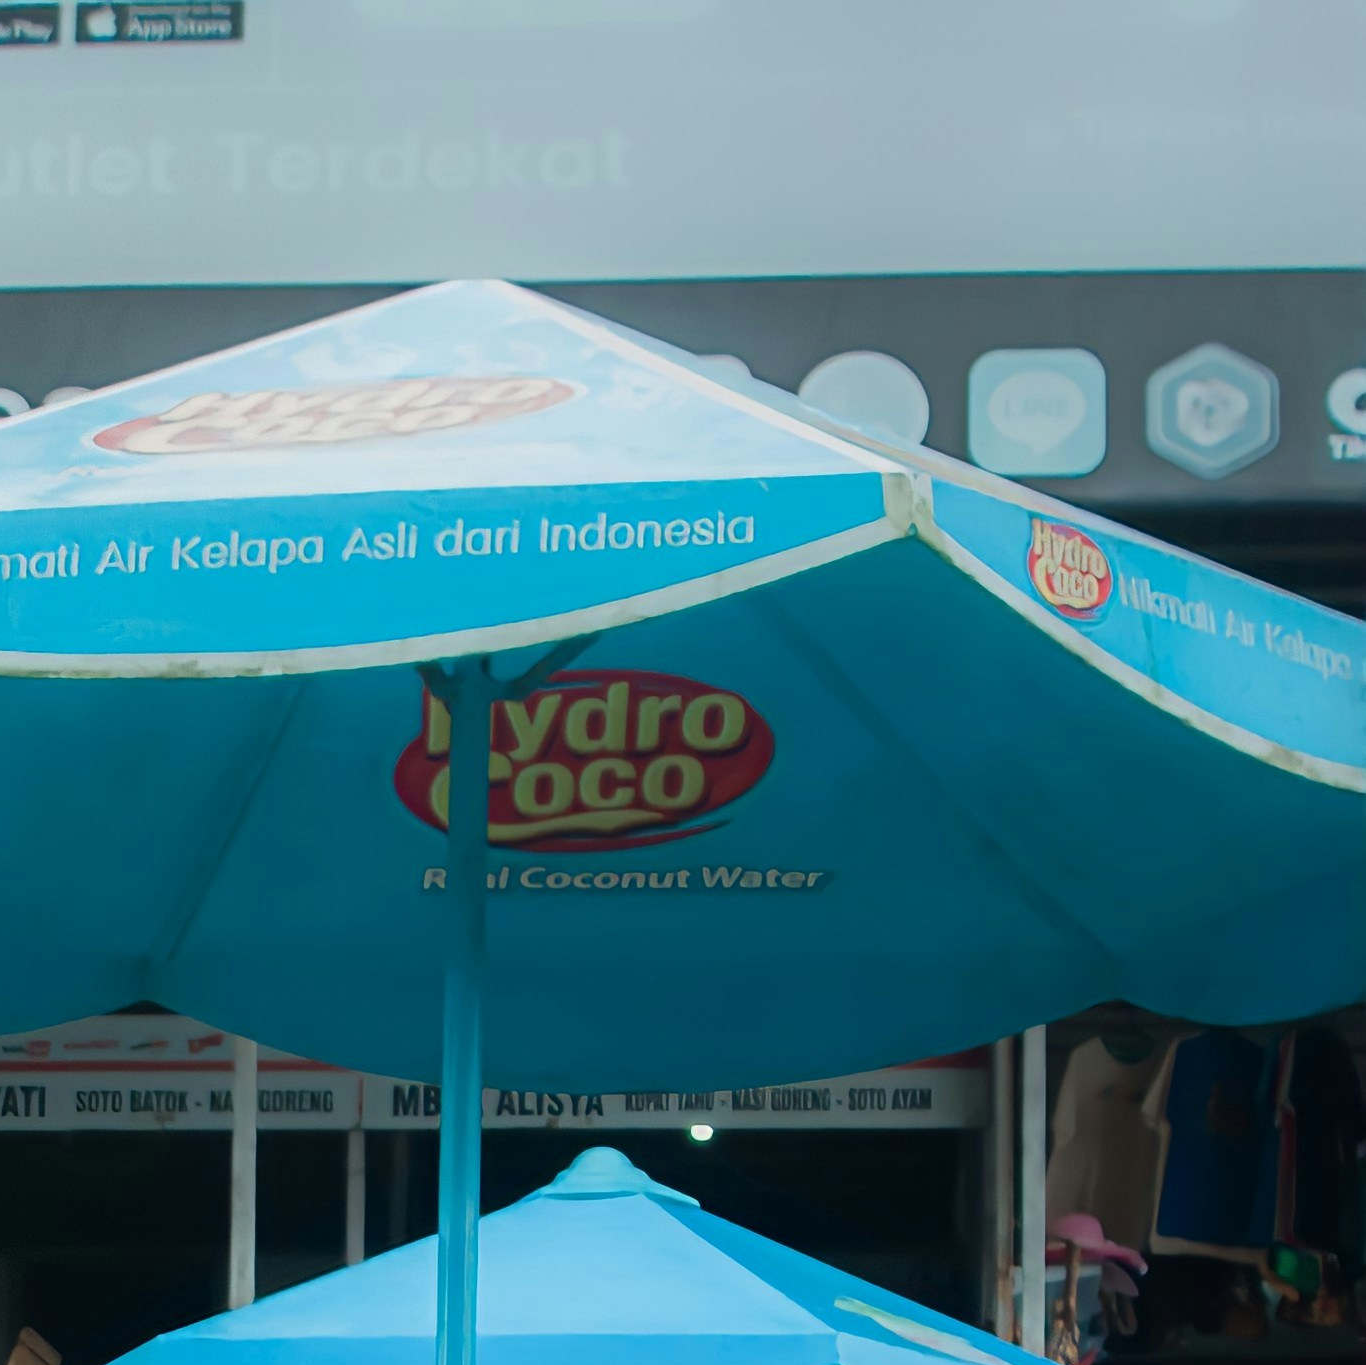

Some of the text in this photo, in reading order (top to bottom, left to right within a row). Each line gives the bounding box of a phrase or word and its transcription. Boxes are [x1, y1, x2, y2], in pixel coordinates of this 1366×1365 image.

[215, 127, 632, 196] Terdekat
[95, 540, 154, 576] Air
[171, 530, 324, 575] Kelapa
[342, 520, 418, 562] Asli
[437, 517, 520, 557] dari
[539, 511, 756, 554] Indonesia
[1031, 518, 1107, 580] Hydro
[1034, 555, 1100, 609] Coco
[520, 866, 692, 890] Coconut
[702, 866, 824, 889] Water
[75, 1090, 123, 1113] SOTO
[848, 1087, 887, 1111] SOTO
[891, 1087, 933, 1110] AYAM
